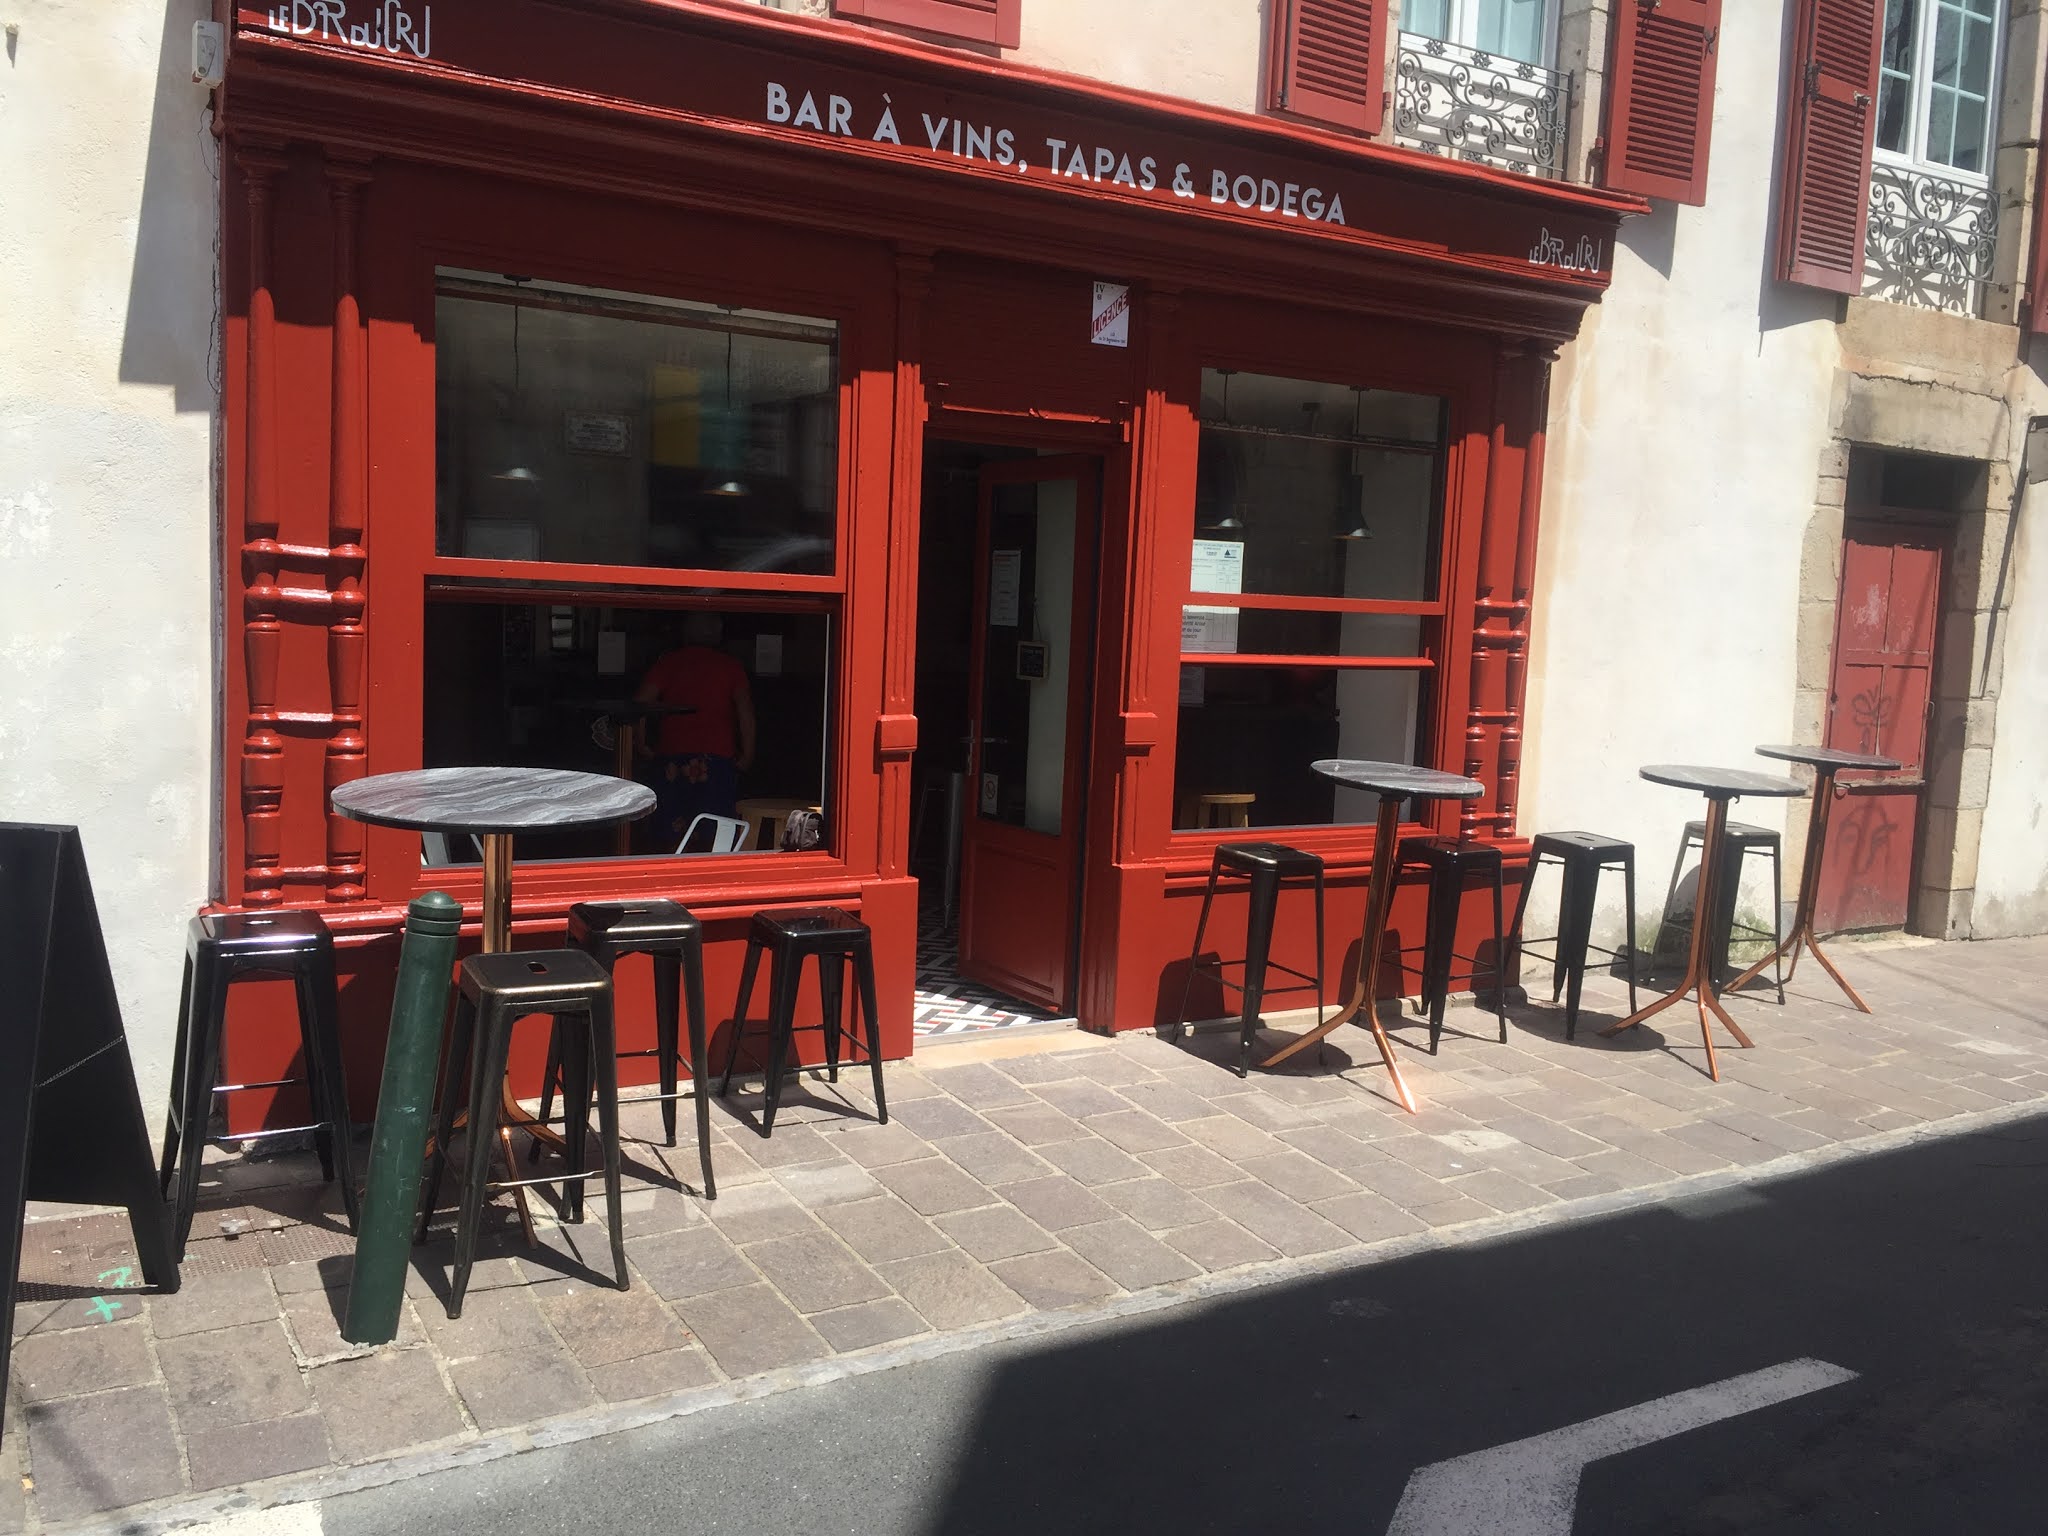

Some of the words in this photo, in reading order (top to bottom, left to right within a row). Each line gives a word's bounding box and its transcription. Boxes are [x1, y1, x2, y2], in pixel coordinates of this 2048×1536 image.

[268, 5, 290, 33] LE
[766, 81, 852, 136] BAR
[873, 92, 901, 145] À
[922, 112, 1028, 174] VINS,
[1046, 137, 1157, 192] TAPAS
[1172, 162, 1196, 199] &
[1210, 169, 1346, 226] BODEGA
[1528, 246, 1539, 264] LE
[1095, 284, 1105, 293] IV
[1093, 292, 1128, 337] LICENCE
